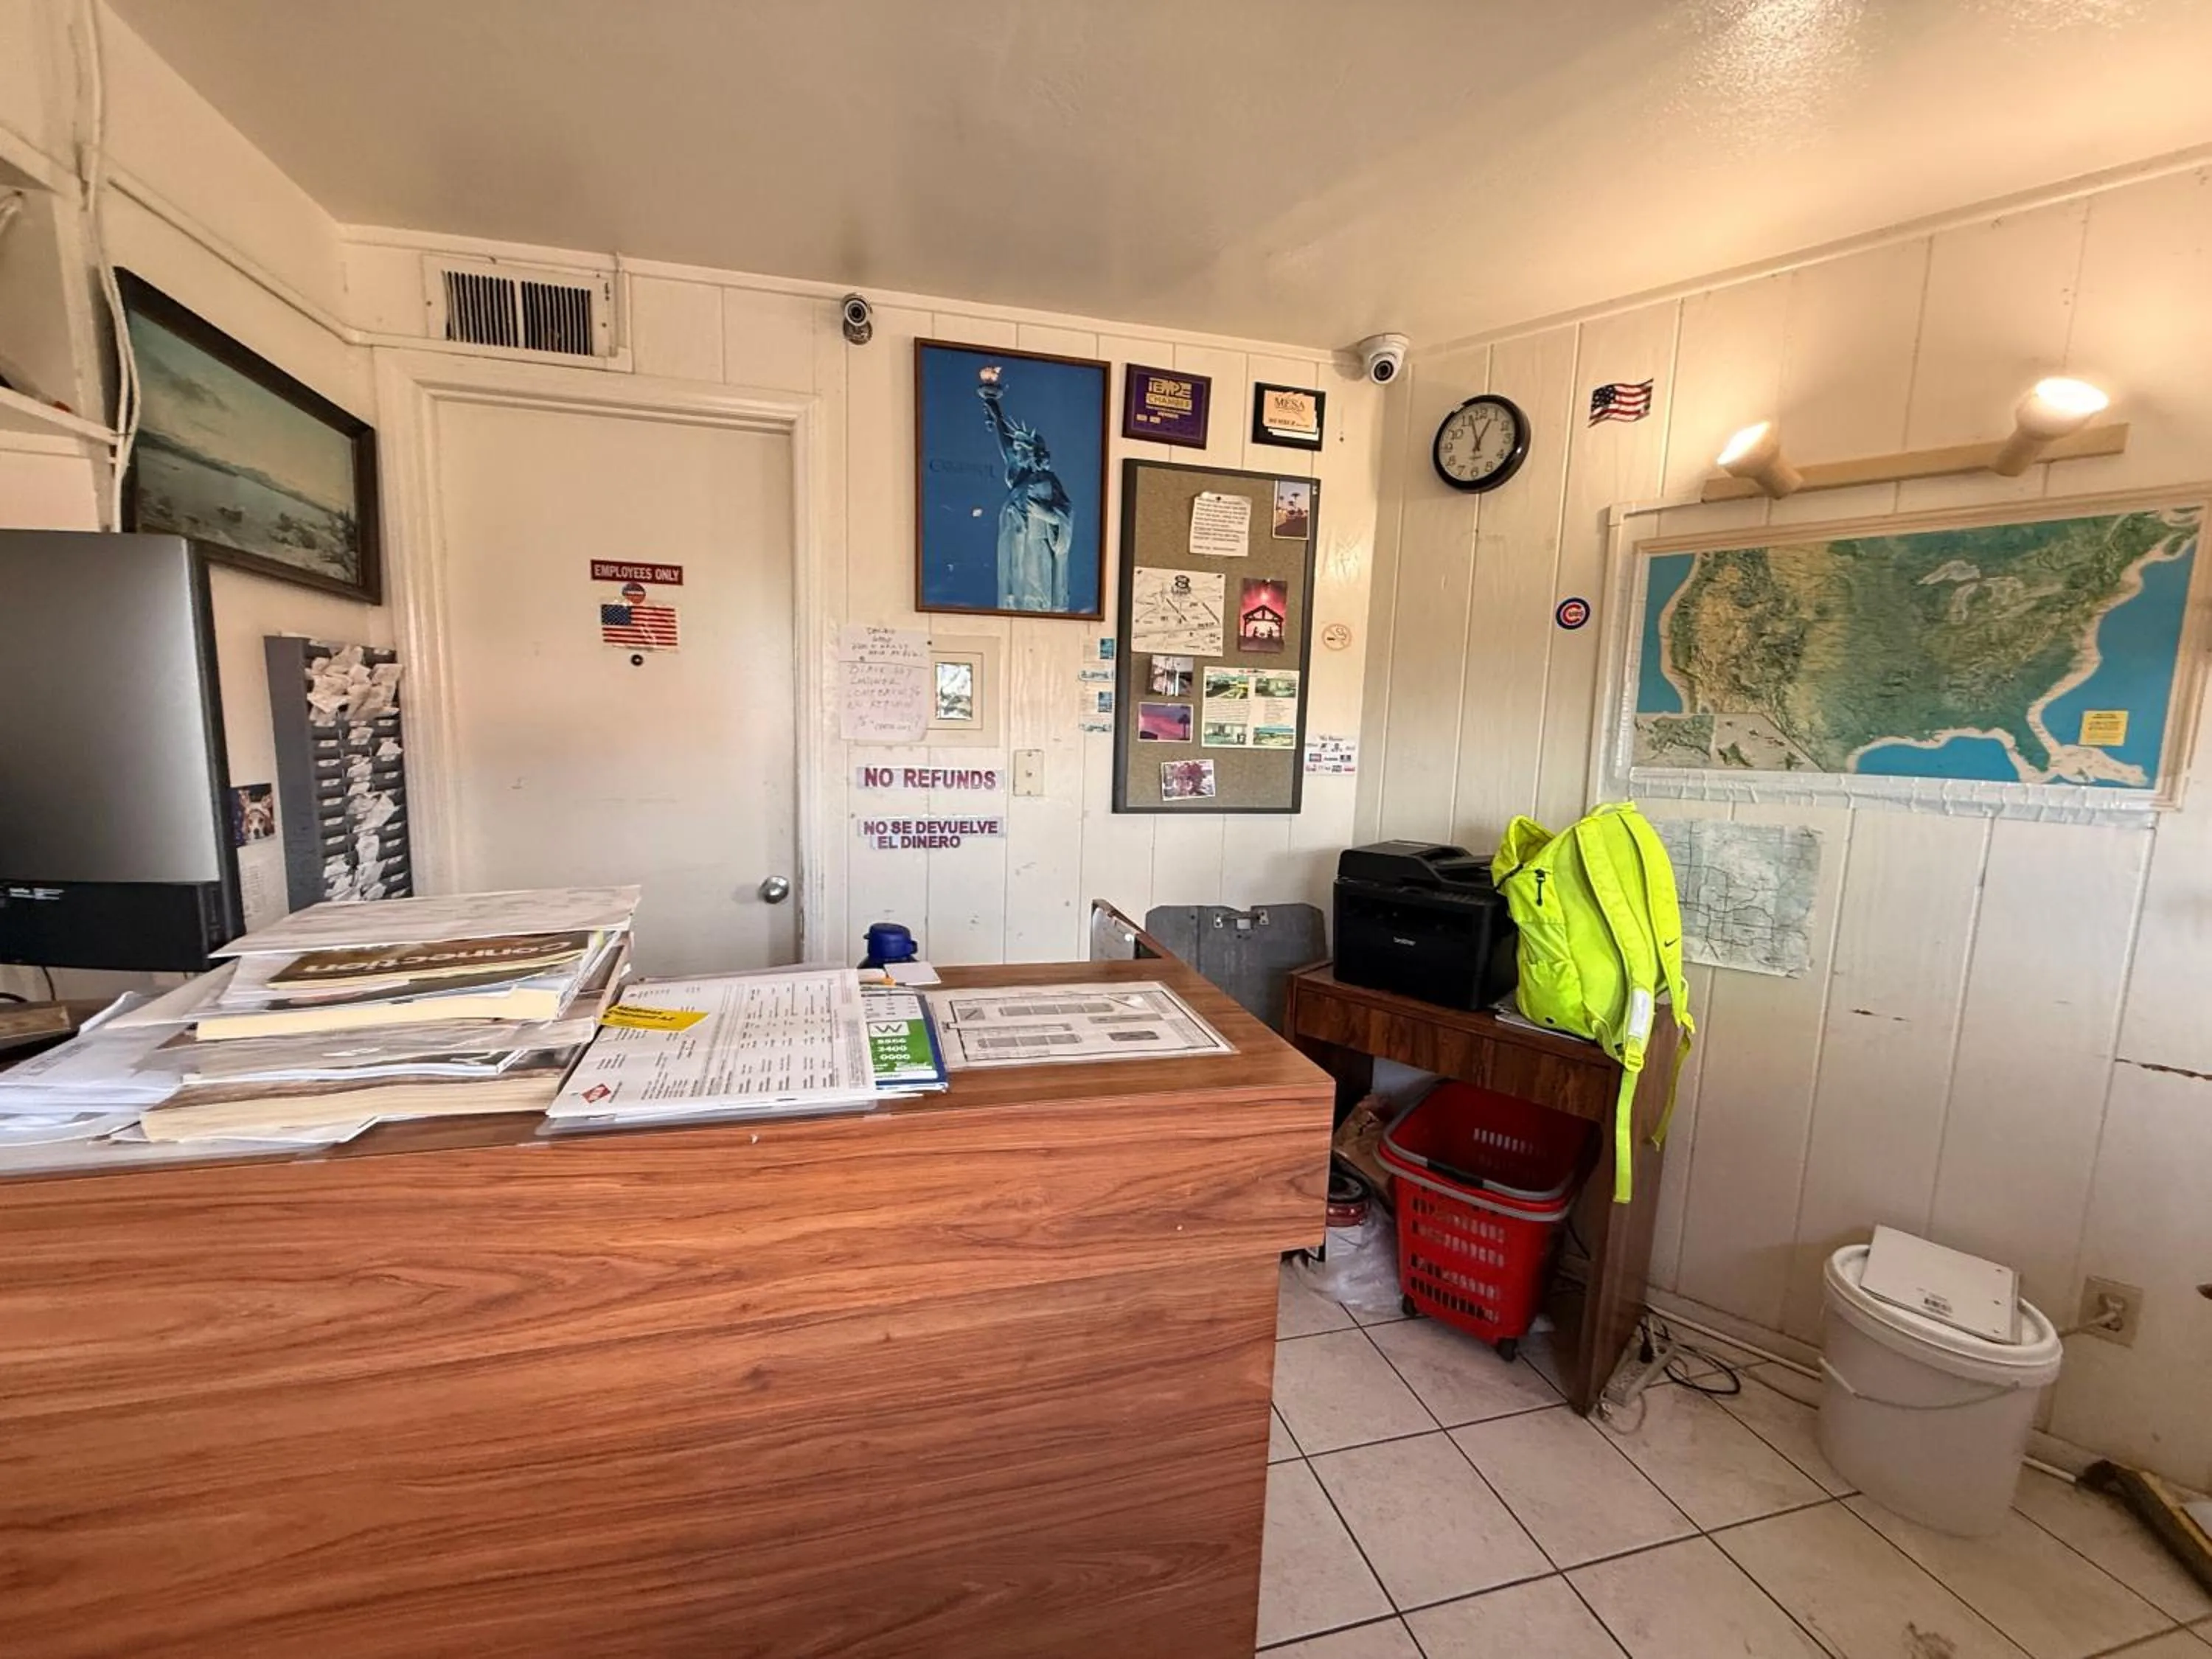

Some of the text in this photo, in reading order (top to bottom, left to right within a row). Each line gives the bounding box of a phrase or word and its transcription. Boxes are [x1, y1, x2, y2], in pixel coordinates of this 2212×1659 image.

[1275, 397, 1305, 411] MESA
[594, 564, 679, 581] EMPLOYEES ONLY
[865, 768, 996, 790] NO REFUNDS
[864, 821, 998, 835] NO SE DEVUELVE
[877, 835, 961, 849] EL DINERO
